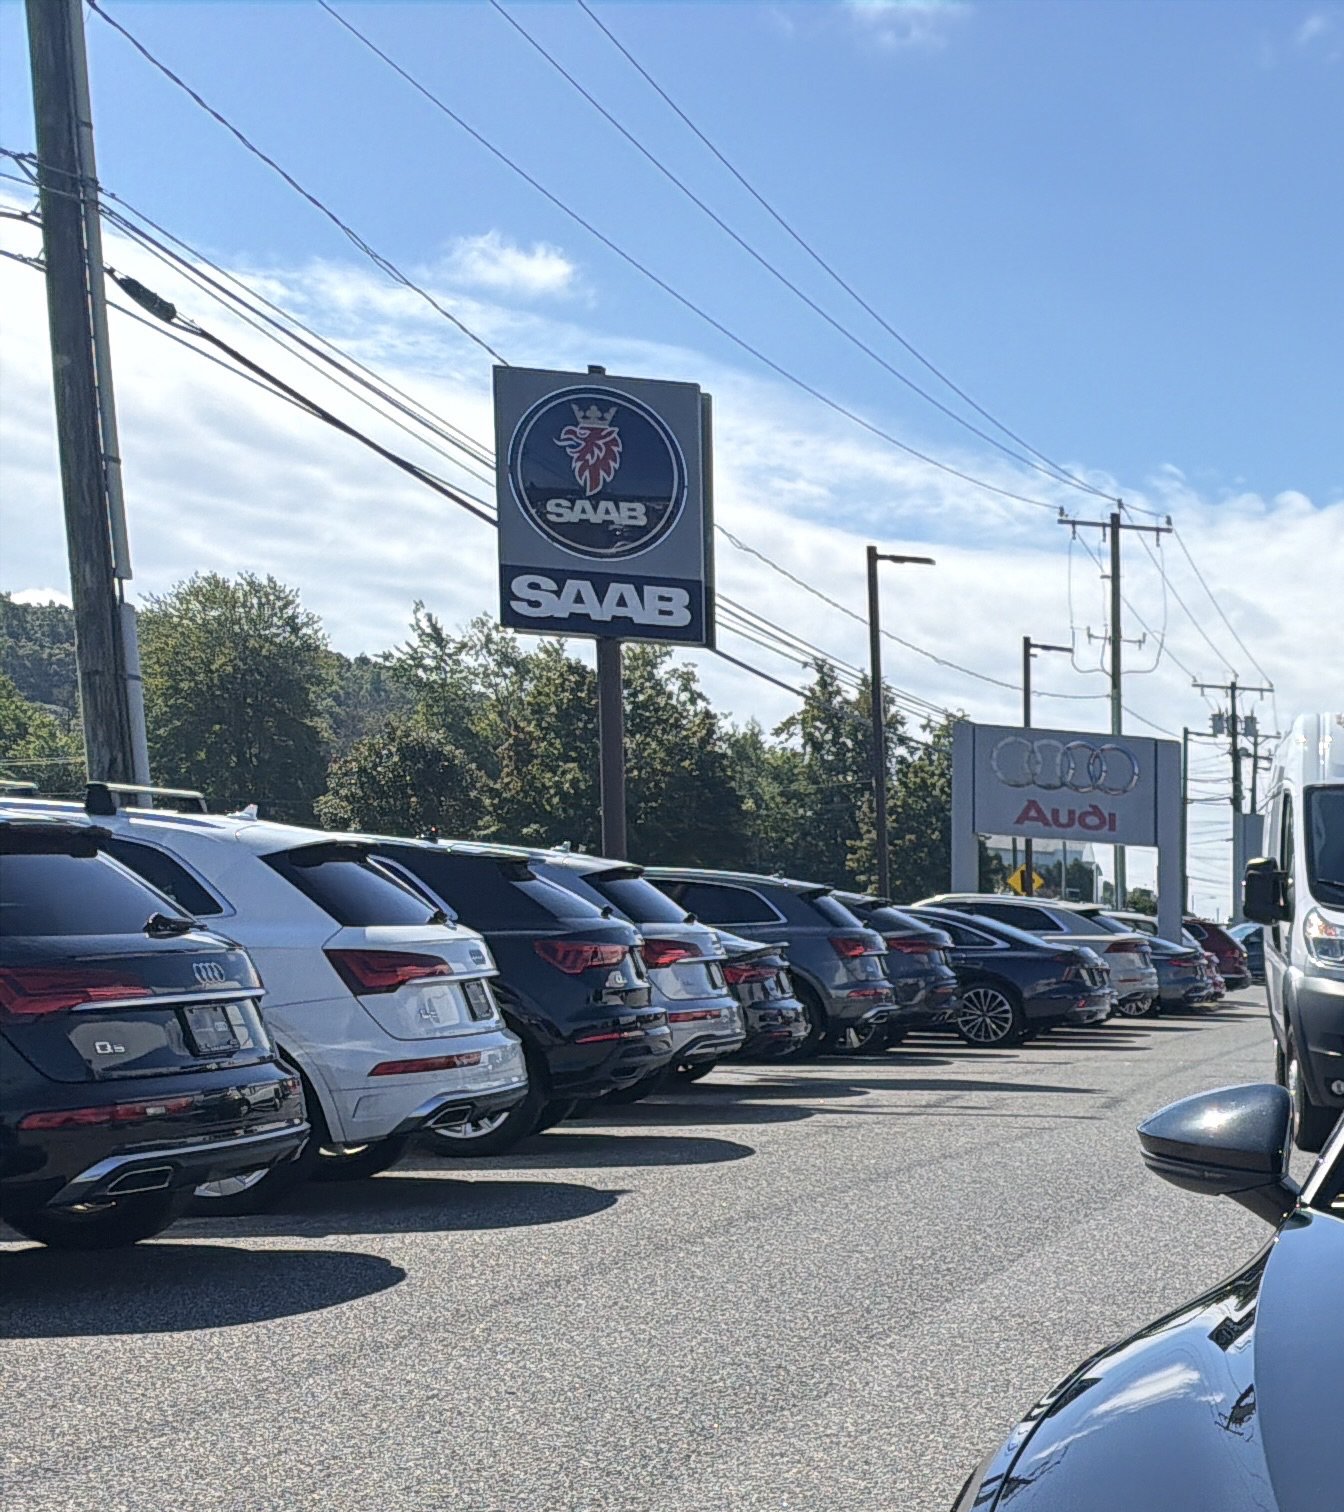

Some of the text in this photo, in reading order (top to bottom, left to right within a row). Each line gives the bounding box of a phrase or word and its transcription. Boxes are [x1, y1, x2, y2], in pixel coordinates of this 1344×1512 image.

[546, 499, 647, 527] SAAB
[510, 574, 692, 627] SAAB
[1013, 799, 1117, 832] Audi
[94, 1041, 125, 1054] Q5
